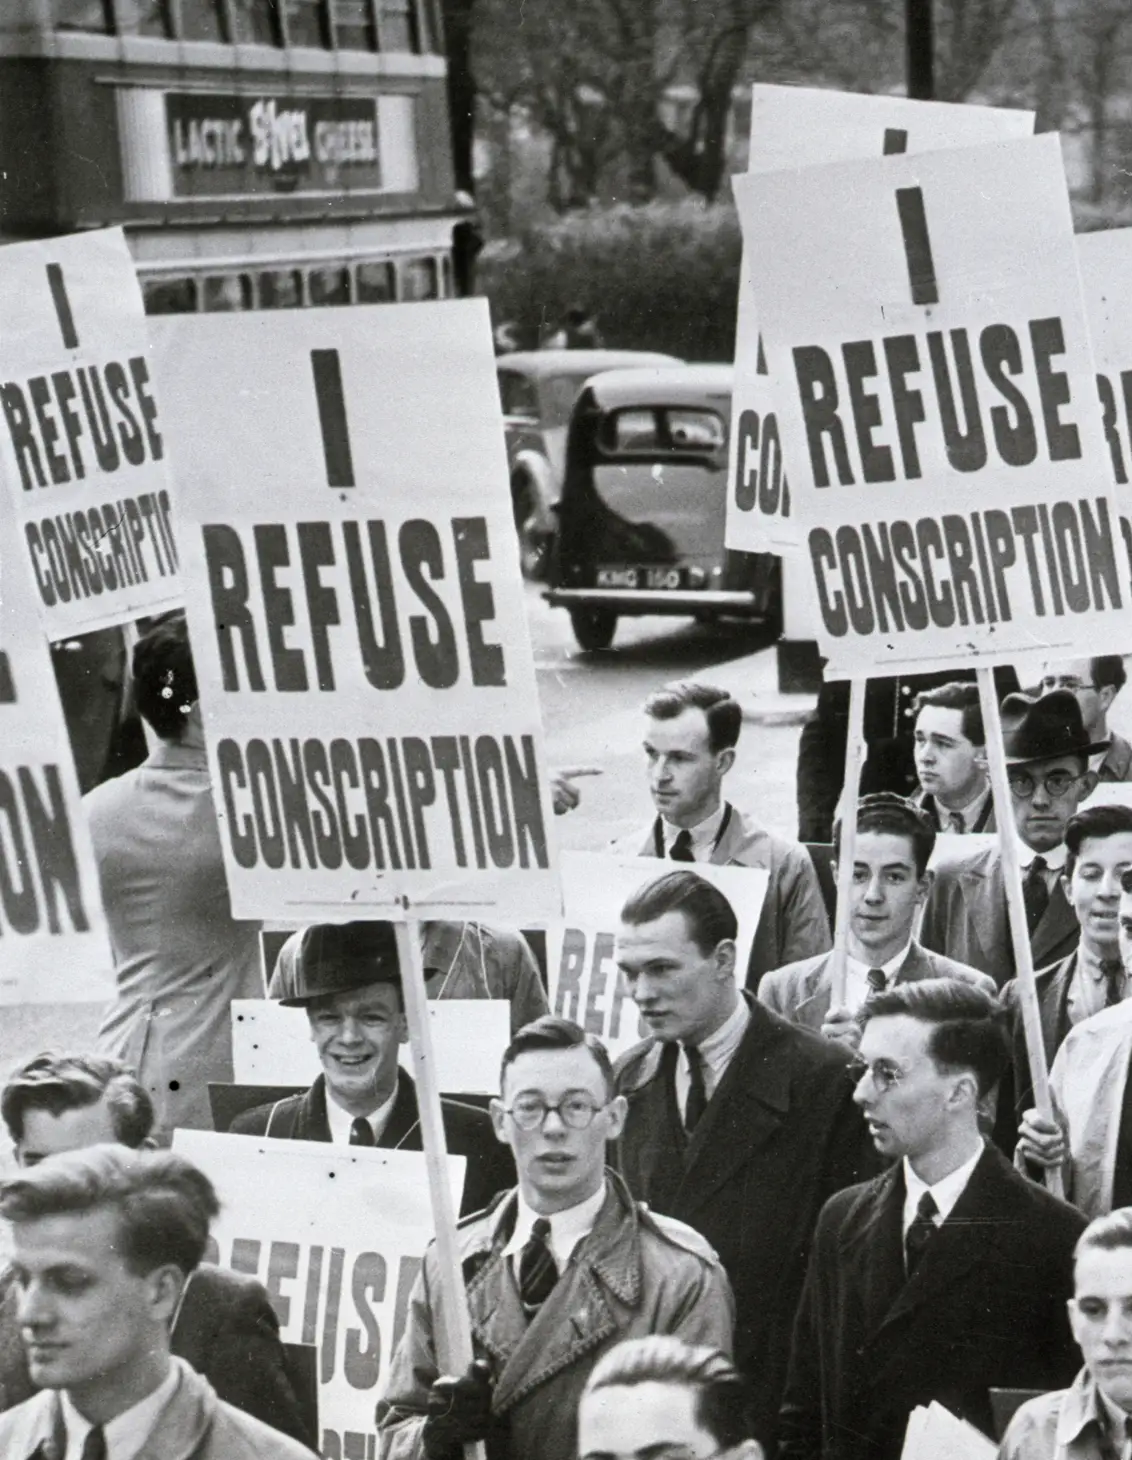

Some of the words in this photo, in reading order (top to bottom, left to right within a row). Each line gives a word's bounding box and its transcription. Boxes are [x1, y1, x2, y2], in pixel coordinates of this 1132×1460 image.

[173, 117, 245, 165] LACTIC
[46, 262, 80, 350] I
[896, 186, 940, 305] I
[0, 356, 164, 492] REFUSE
[310, 347, 356, 488] I
[734, 409, 791, 518] CO
[792, 316, 1083, 489] REFUSE
[201, 516, 508, 693] REFUSE
[808, 497, 1123, 638] CONSCRIPTION
[216, 734, 549, 870] CONSCRIPTION
